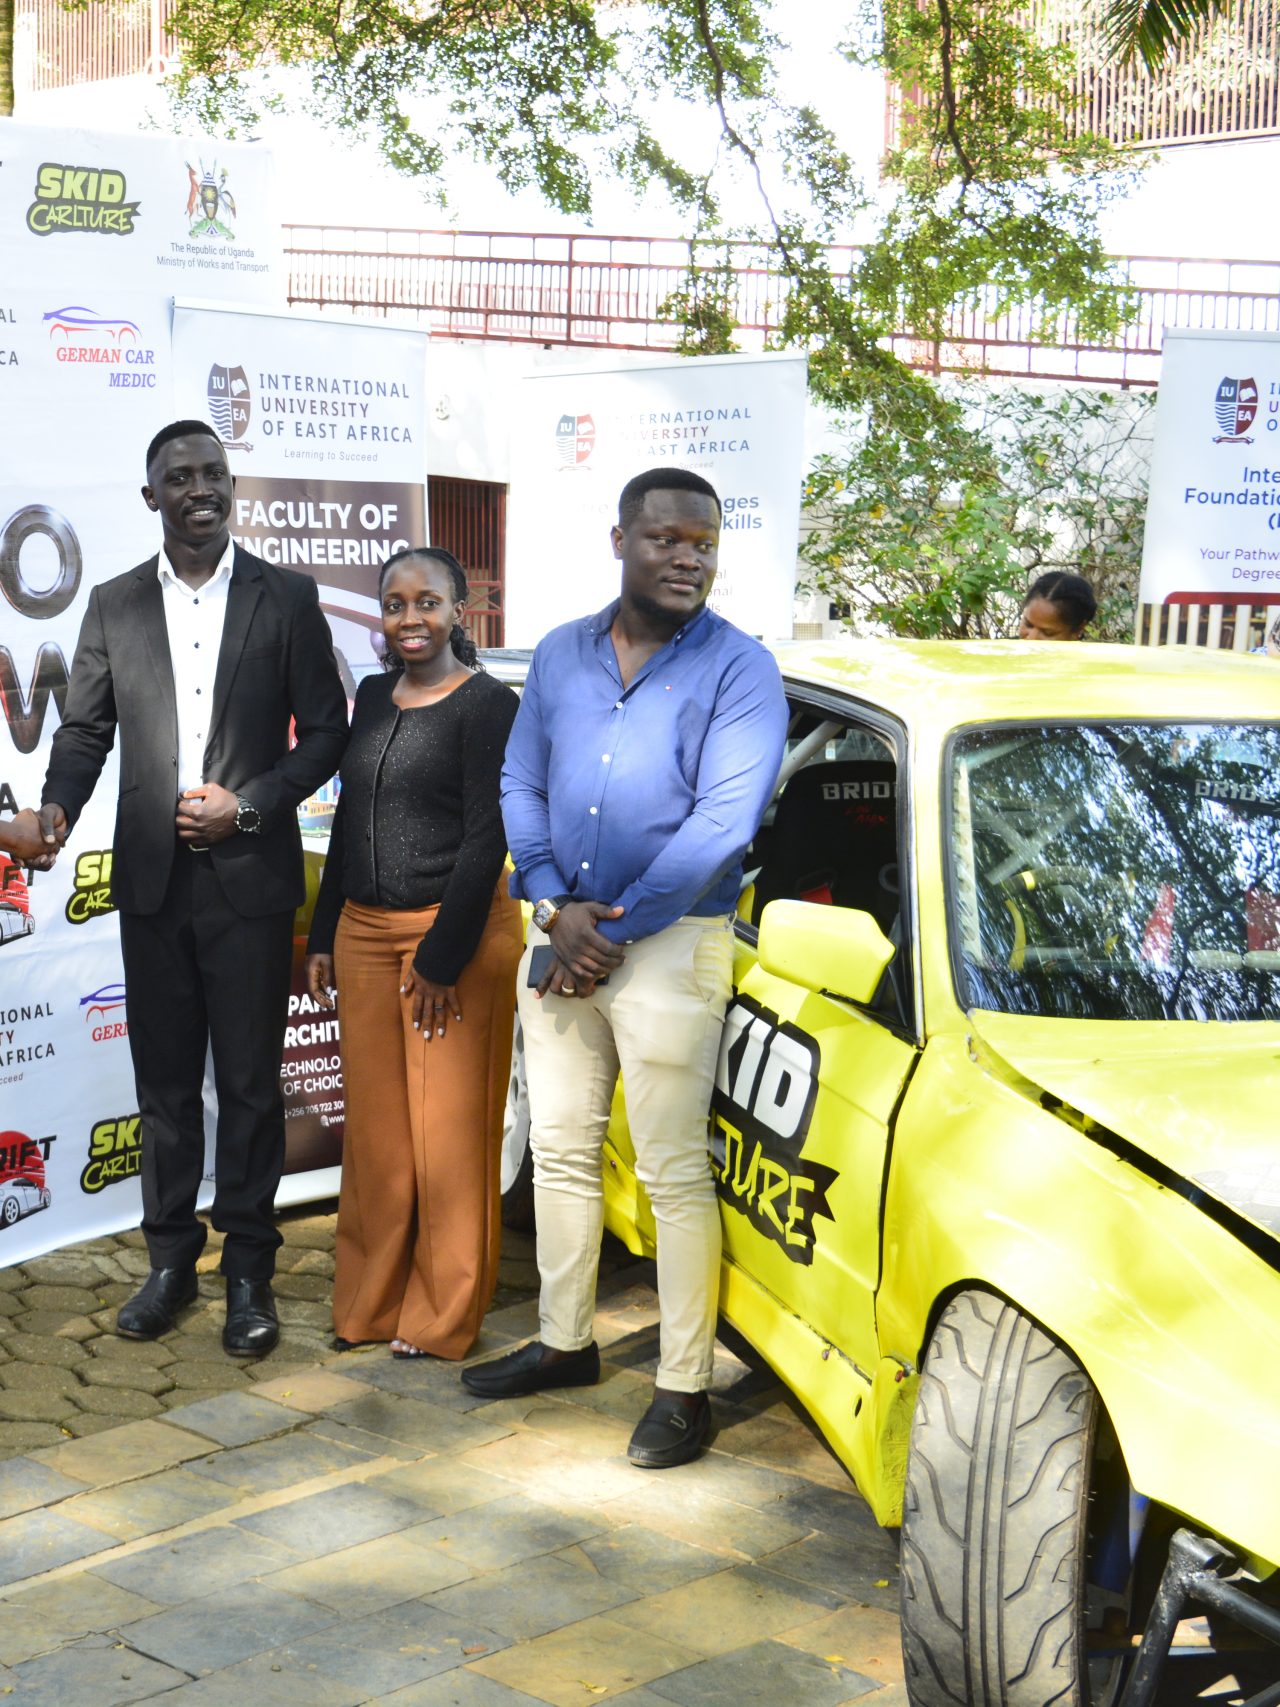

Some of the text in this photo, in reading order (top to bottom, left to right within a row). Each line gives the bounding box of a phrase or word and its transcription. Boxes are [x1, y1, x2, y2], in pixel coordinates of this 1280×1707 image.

[38, 166, 124, 203] SKID
[30, 203, 132, 231] CARLTURE
[170, 242, 255, 258] The Republic of Uganda
[156, 256, 269, 273] Ministry of Works and Transport
[56, 347, 154, 365] GERMAN CAR
[109, 372, 156, 388] MEDIC
[212, 376, 225, 390] IU
[259, 373, 410, 399] INTERNATIONAL
[1220, 386, 1234, 397] IU
[232, 408, 247, 422] EA
[261, 397, 369, 418] UNIVERSITY
[1238, 411, 1252, 421] EA
[639, 408, 751, 425] ERNATIONAL
[263, 420, 412, 443] OF EAST AFRICA
[638, 426, 709, 440] VERSITY
[284, 449, 378, 462] Learning to Succeed
[687, 440, 750, 455] AFRICA
[1243, 467, 1280, 483] Inte
[723, 496, 759, 513] ges
[235, 499, 398, 530] FACULTY OF
[723, 514, 762, 530] kills
[232, 536, 410, 565] NGINEERIN
[1199, 548, 1280, 561] Your Pathw
[821, 781, 897, 800] BRID
[284, 1020, 340, 1048] RCHIT
[280, 1055, 340, 1077] ECHNOLO
[714, 1003, 812, 1139] KID
[284, 1073, 343, 1095] OF CHOIC
[319, 1102, 333, 1112] 722
[91, 1118, 142, 1156] SK
[83, 1150, 142, 1189] CARLT
[710, 1108, 814, 1248] TURE
